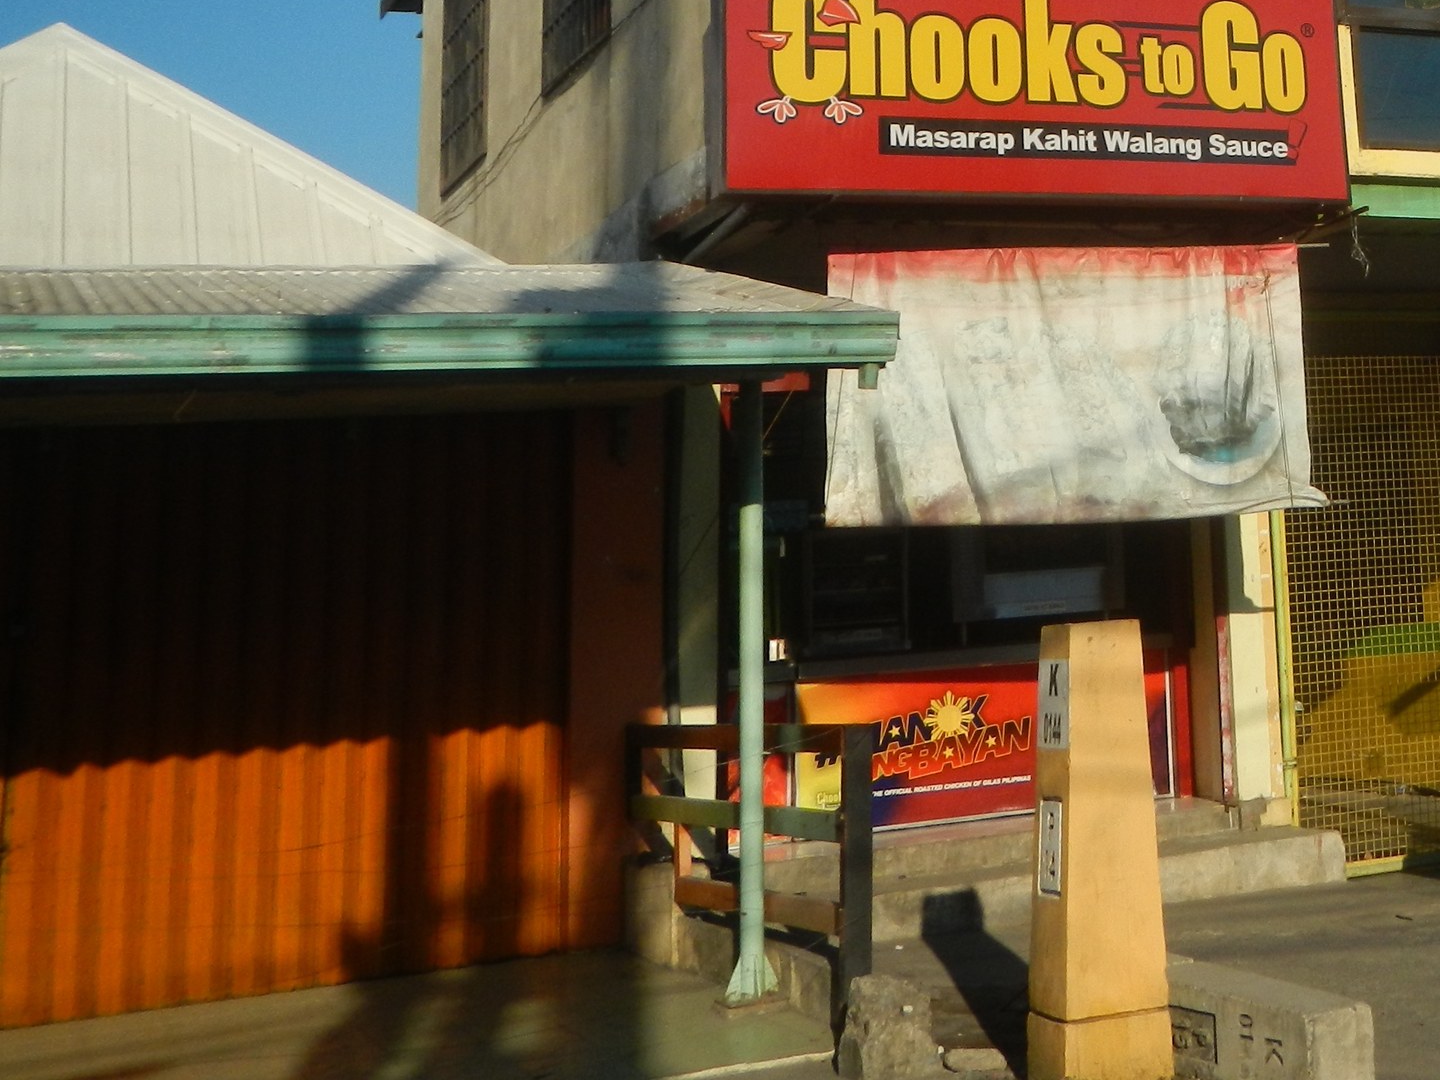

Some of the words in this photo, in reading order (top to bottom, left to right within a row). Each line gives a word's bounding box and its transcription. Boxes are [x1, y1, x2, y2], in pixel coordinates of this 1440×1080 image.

[1140, 33, 1196, 99] to
[889, 123, 1014, 156] Masarap
[1022, 126, 1098, 153] Kahit
[1103, 129, 1202, 162] Walang
[1208, 134, 1289, 159] Sauce
[1048, 663, 1059, 697] K
[884, 786, 913, 797] OFFICIAL
[914, 783, 943, 794] ROASTED
[944, 781, 972, 790] CHICKEN
[982, 777, 1001, 786] GILAS
[1001, 774, 1032, 784] PILIPINAS
[1264, 1037, 1284, 1066] K
